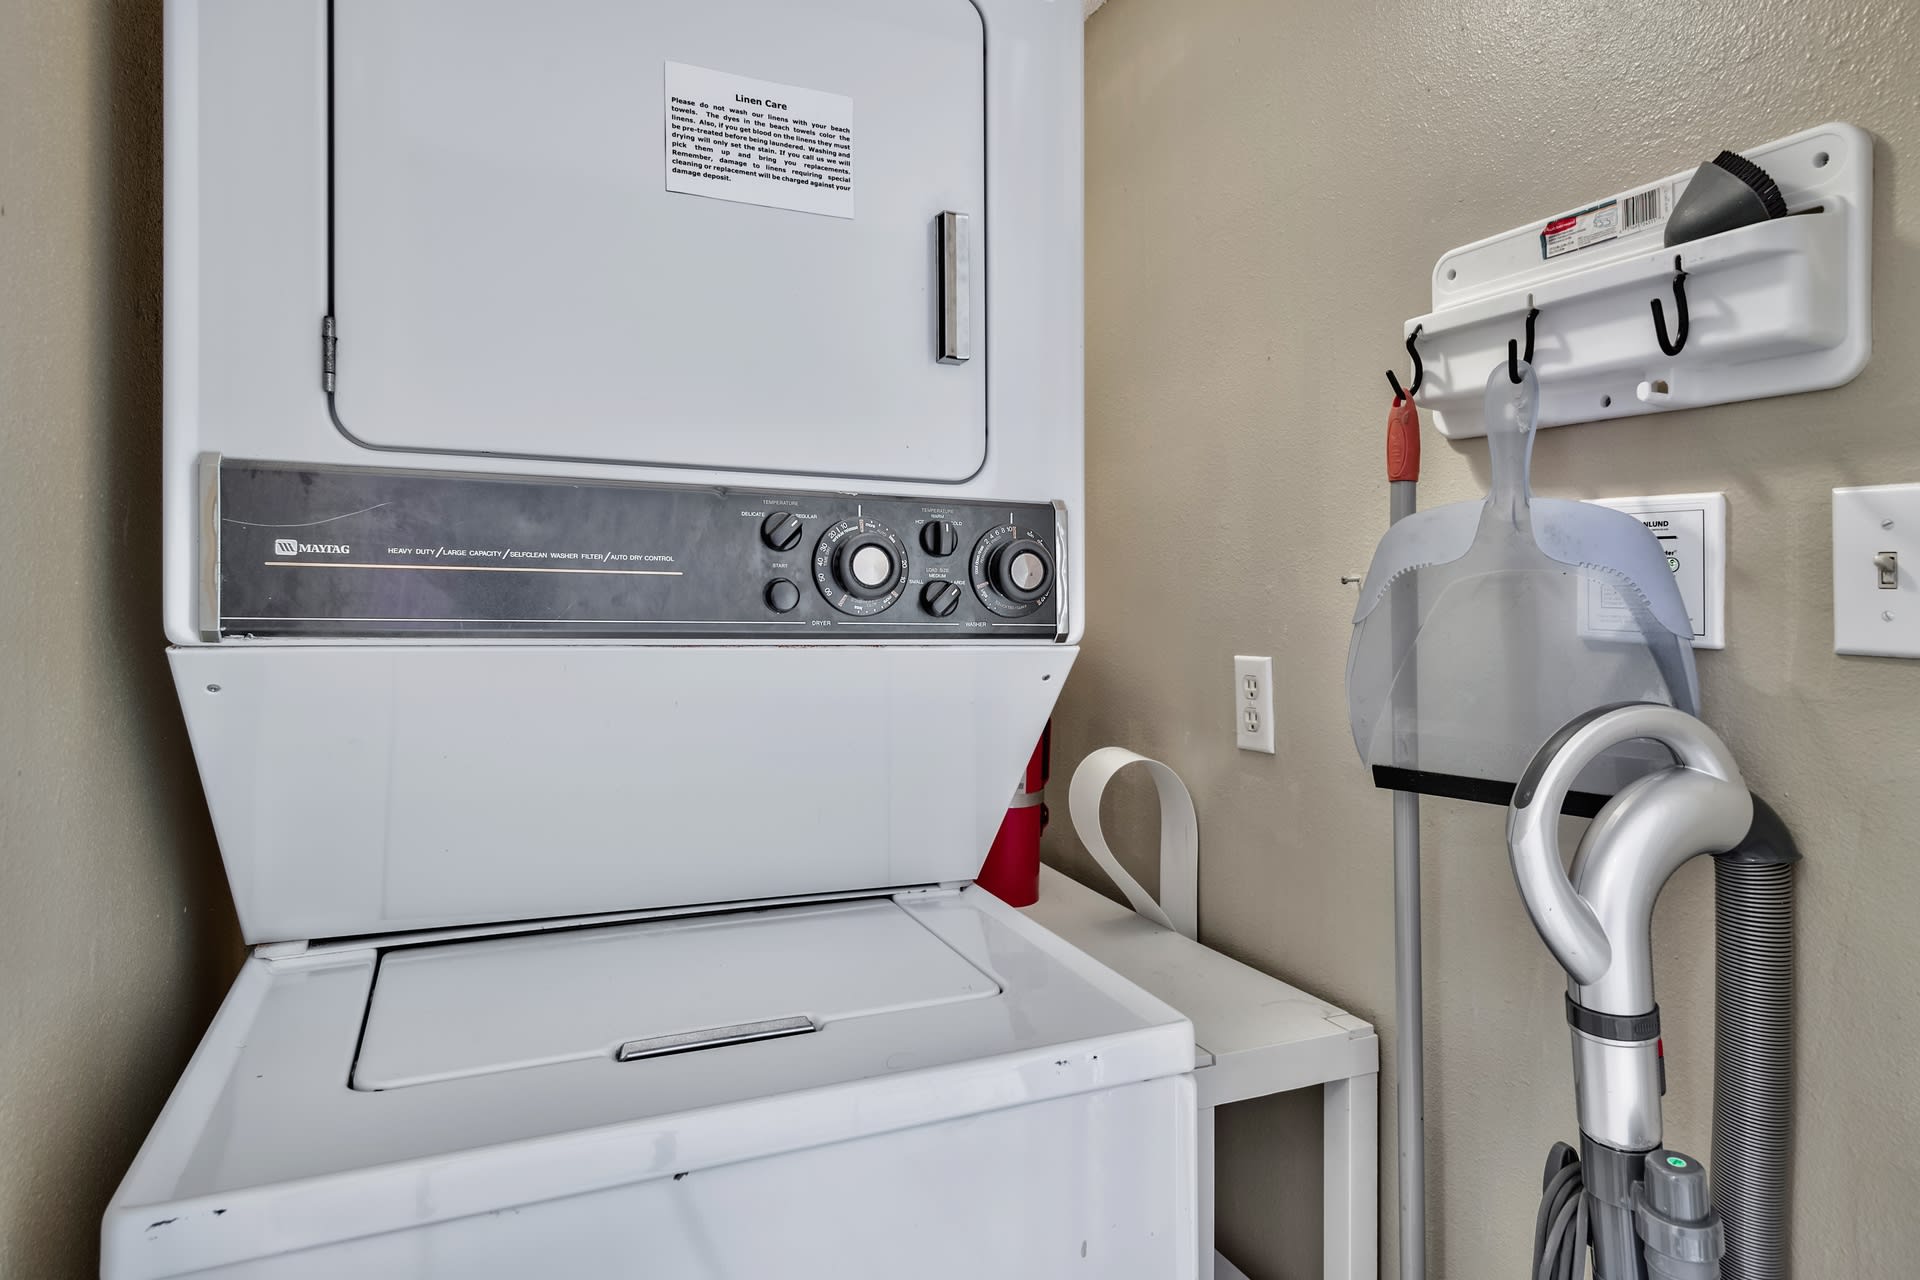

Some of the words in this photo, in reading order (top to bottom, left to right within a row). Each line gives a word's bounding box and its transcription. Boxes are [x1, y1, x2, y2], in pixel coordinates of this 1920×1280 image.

[672, 97, 695, 106] Please
[768, 114, 788, 122] linens
[736, 94, 762, 105] Linen
[765, 100, 787, 110] Care
[672, 106, 698, 115] towels.
[770, 123, 789, 131] beach
[794, 127, 815, 135] towels
[672, 114, 695, 123] linens.
[699, 120, 716, 128] Also,
[753, 128, 771, 136] blood
[796, 136, 816, 144] linens
[672, 132, 695, 141] drying
[682, 126, 723, 137] pre-treated
[725, 132, 747, 141] before
[749, 136, 768, 145] being
[770, 140, 805, 151] laundered.
[808, 146, 836, 157] Washing
[672, 150, 713, 162] Remember,
[719, 158, 747, 167] damage
[792, 169, 822, 179] requiring
[672, 159, 702, 169] cleaning
[713, 166, 756, 177] replacement
[782, 176, 808, 184] charged
[672, 168, 701, 177] damage
[703, 173, 731, 181] deposit.
[759, 155, 776, 163] bring
[804, 163, 850, 174] replacements.
[300, 543, 350, 554] MAYTAG
